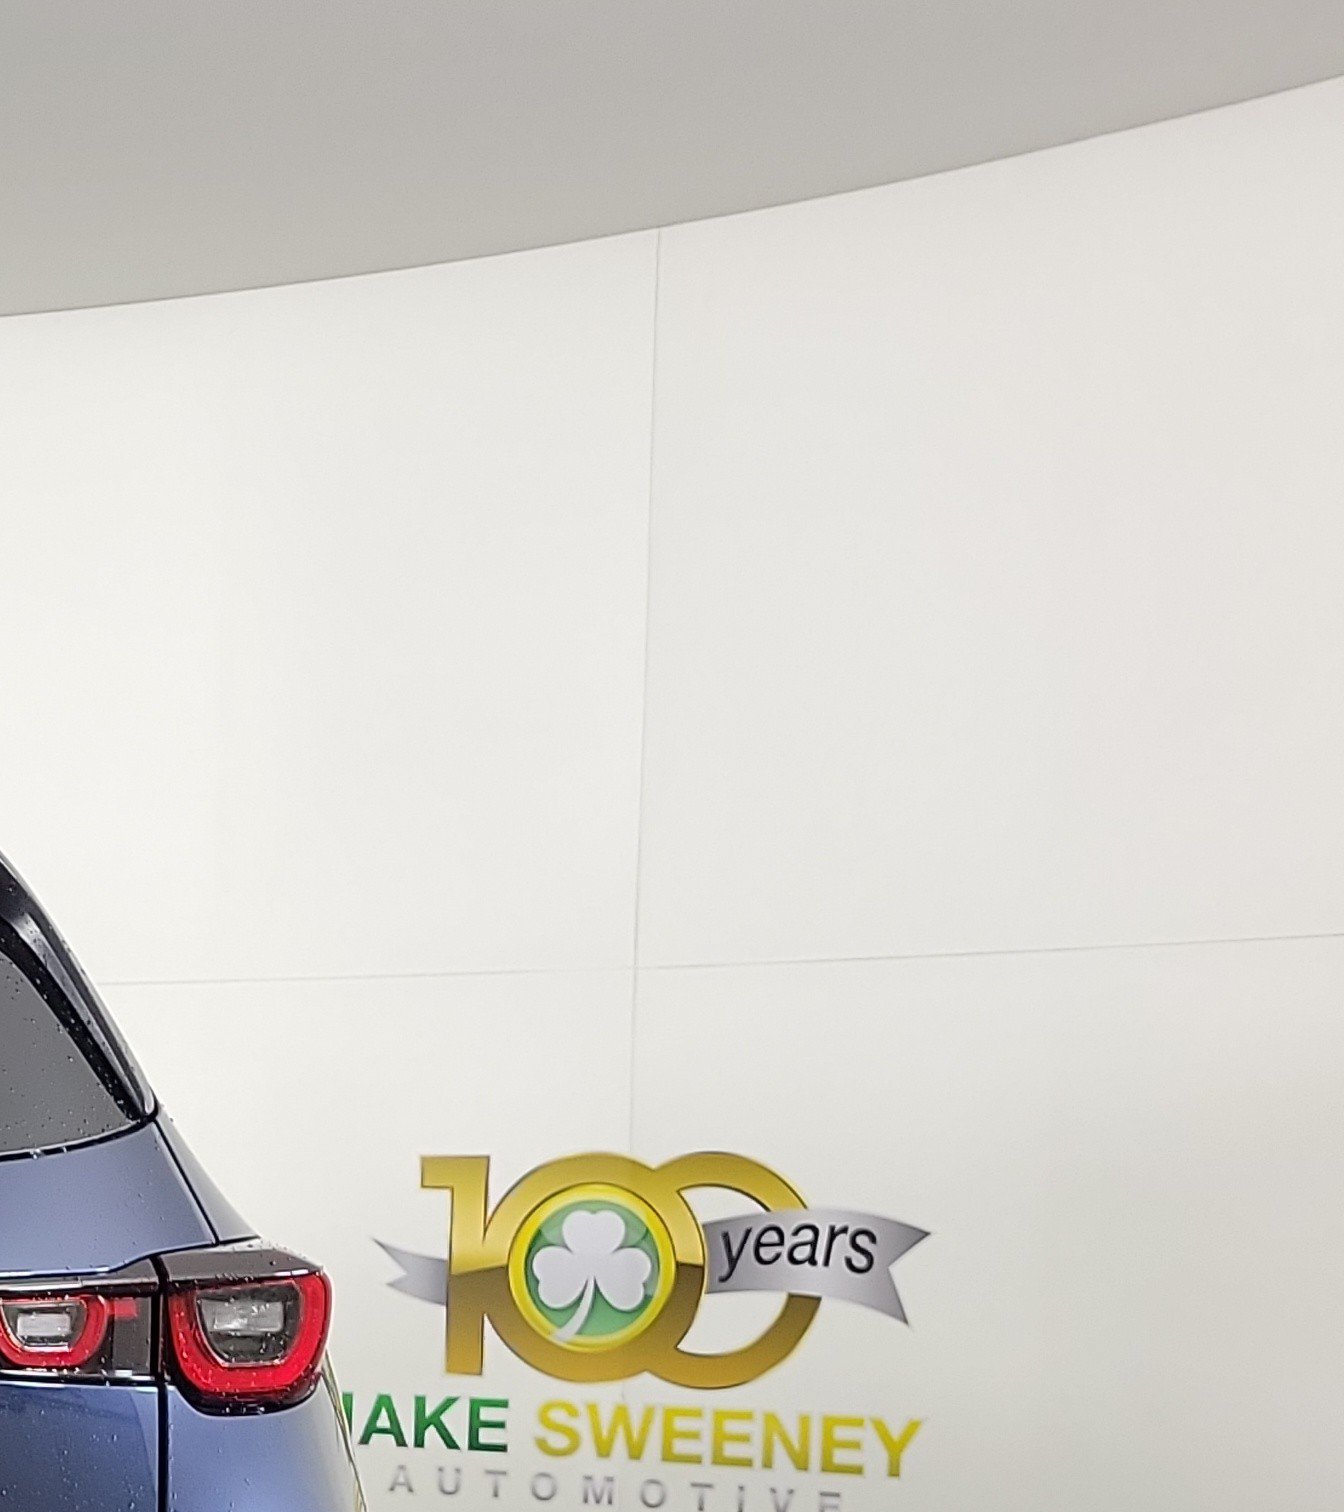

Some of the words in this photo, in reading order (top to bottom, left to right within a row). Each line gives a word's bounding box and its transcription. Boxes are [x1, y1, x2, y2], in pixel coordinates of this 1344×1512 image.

[418, 1150, 823, 1390] 100
[716, 1219, 879, 1283] years
[533, 1398, 923, 1479] SWEENEY
